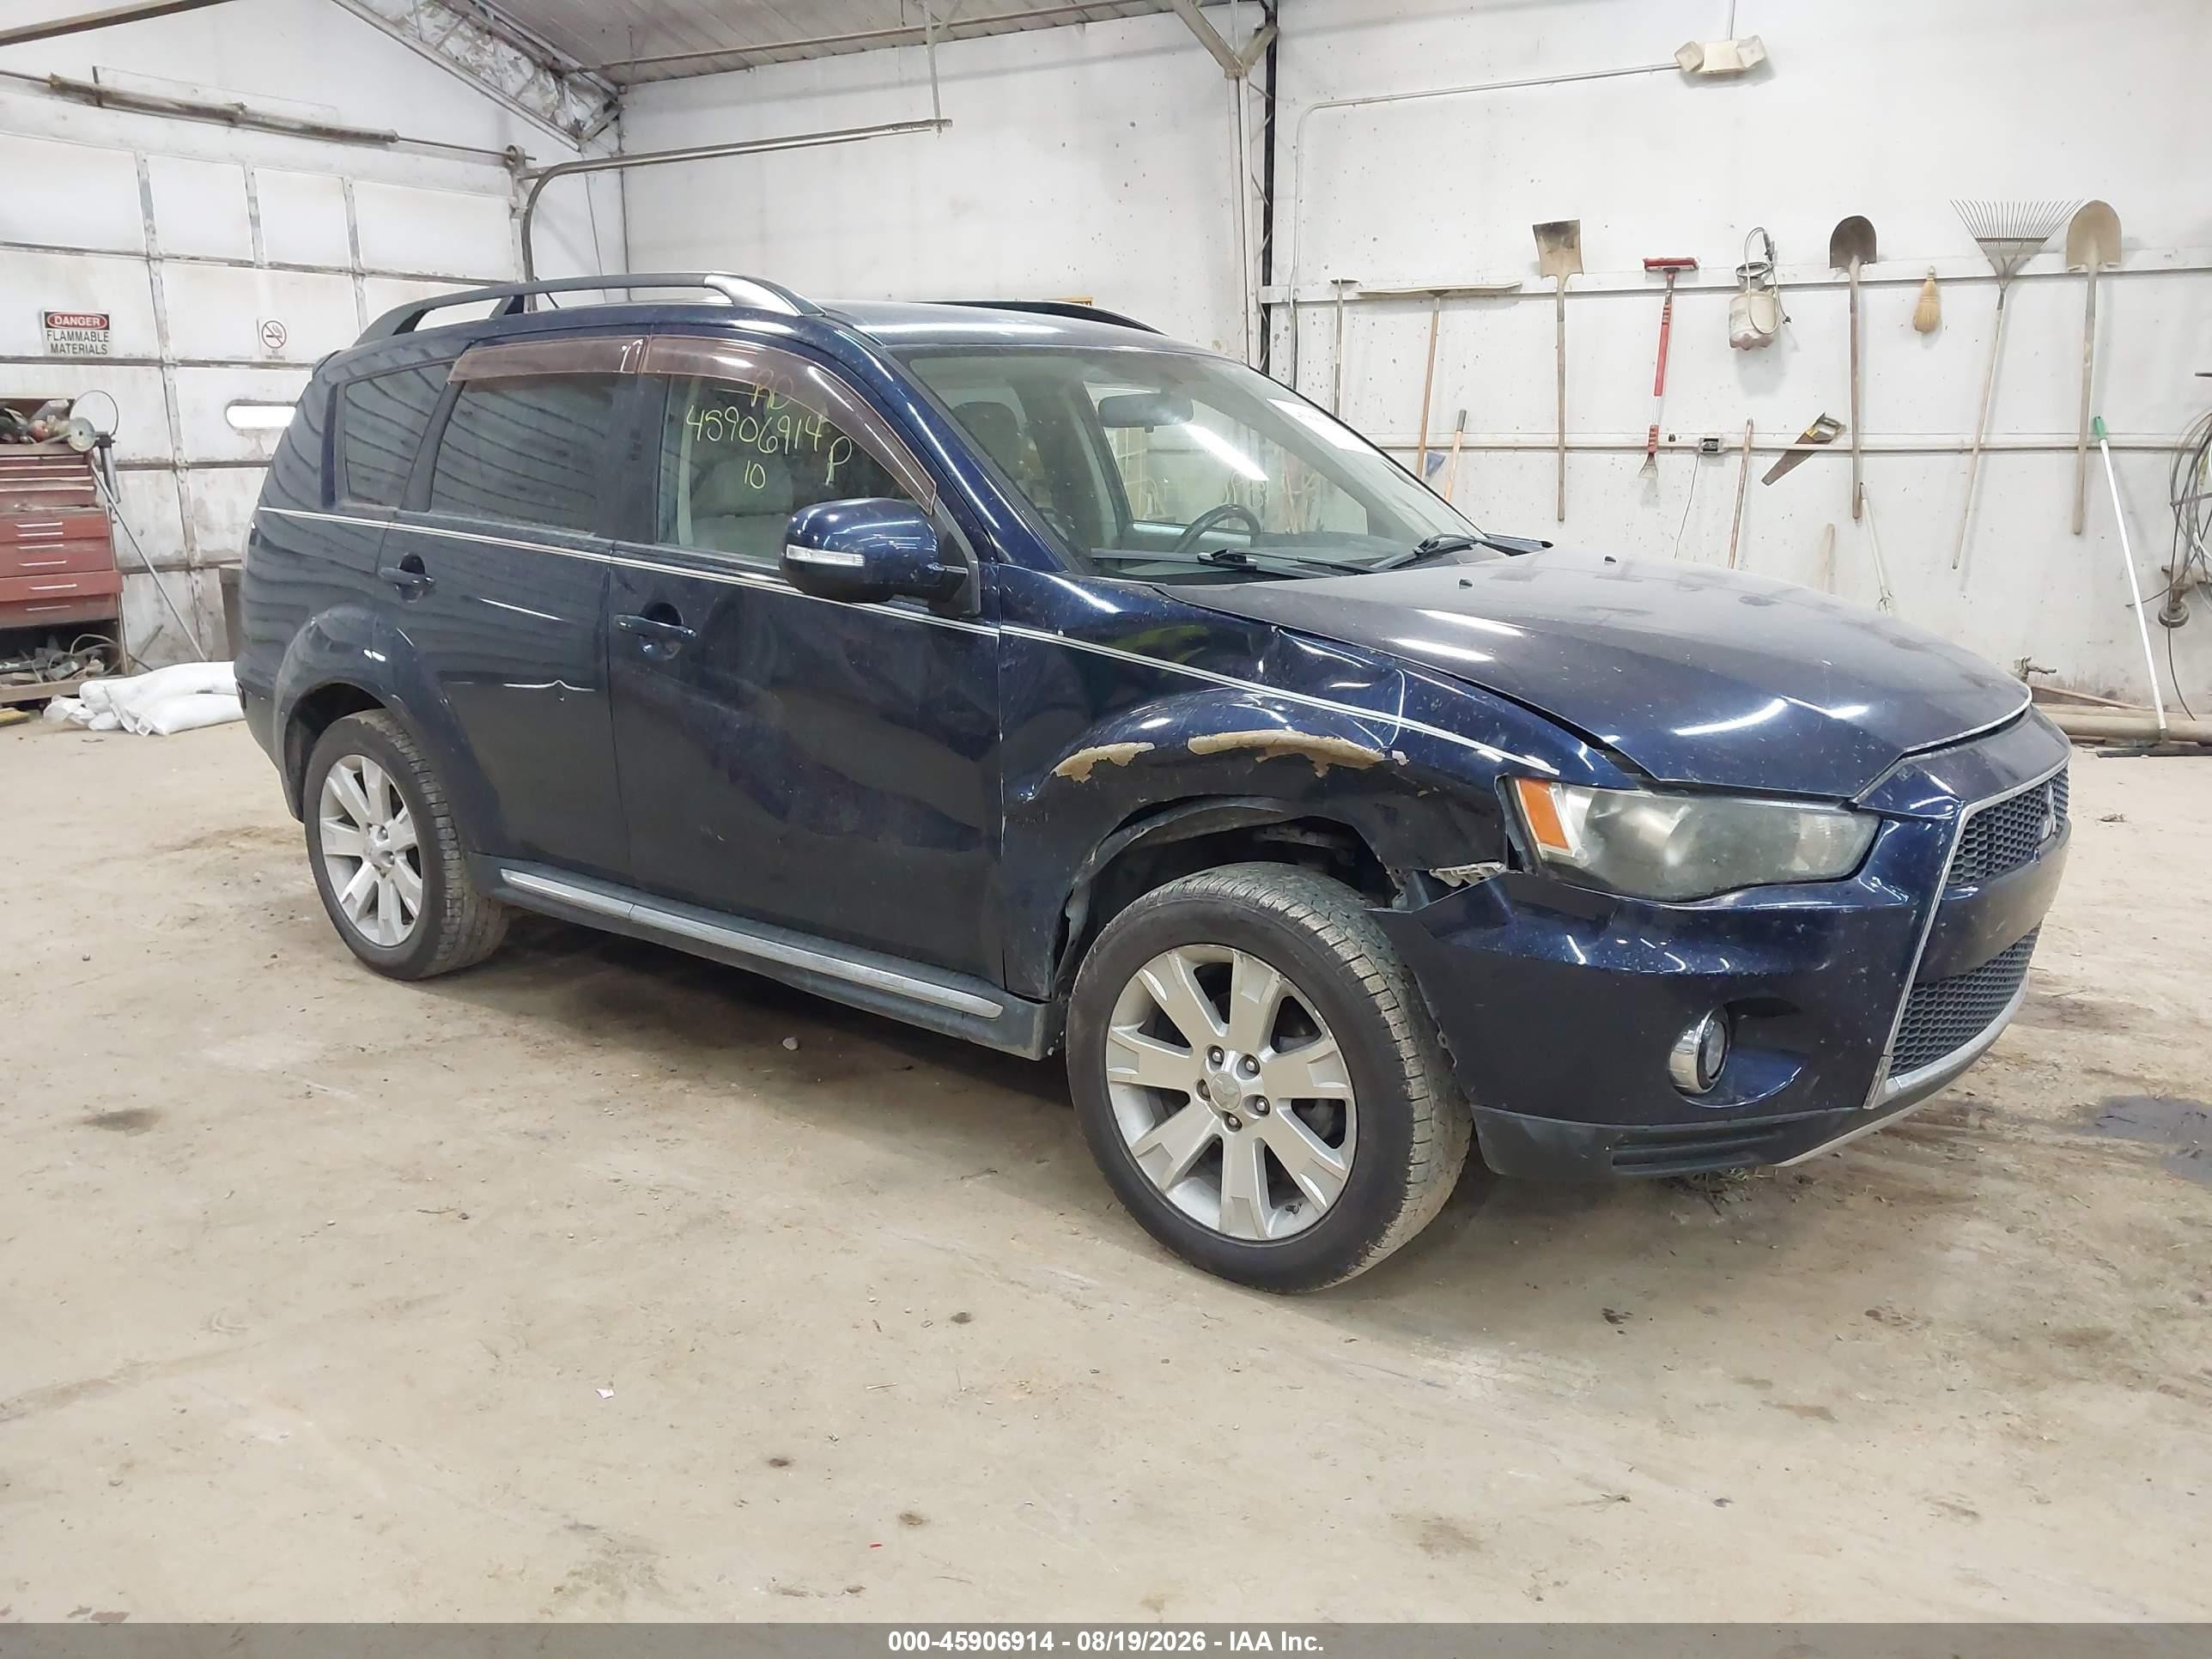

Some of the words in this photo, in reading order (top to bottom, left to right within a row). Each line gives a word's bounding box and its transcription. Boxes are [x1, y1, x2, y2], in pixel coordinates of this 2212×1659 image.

[54, 315, 100, 326] DANGER
[46, 330, 110, 343] FLAMMABLE
[50, 343, 108, 355] MATERIALS
[686, 404, 823, 455] 45906914
[744, 459, 766, 489] 10
